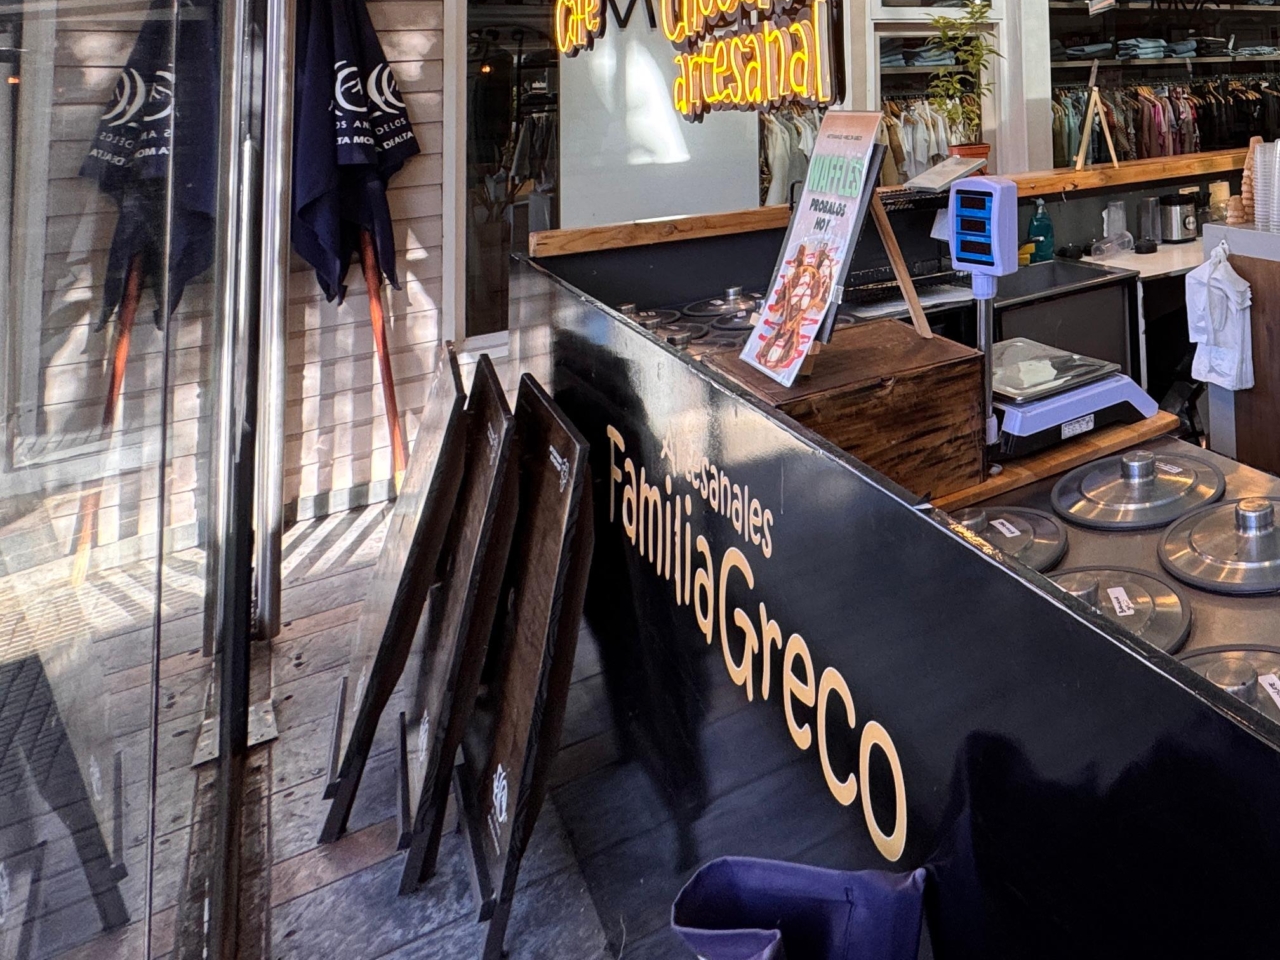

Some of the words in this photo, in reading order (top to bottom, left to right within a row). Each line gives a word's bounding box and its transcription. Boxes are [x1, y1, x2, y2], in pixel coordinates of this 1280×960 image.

[808, 153, 865, 198] WAFFLES
[809, 197, 847, 218] PROBALOS
[813, 216, 831, 233] HOY
